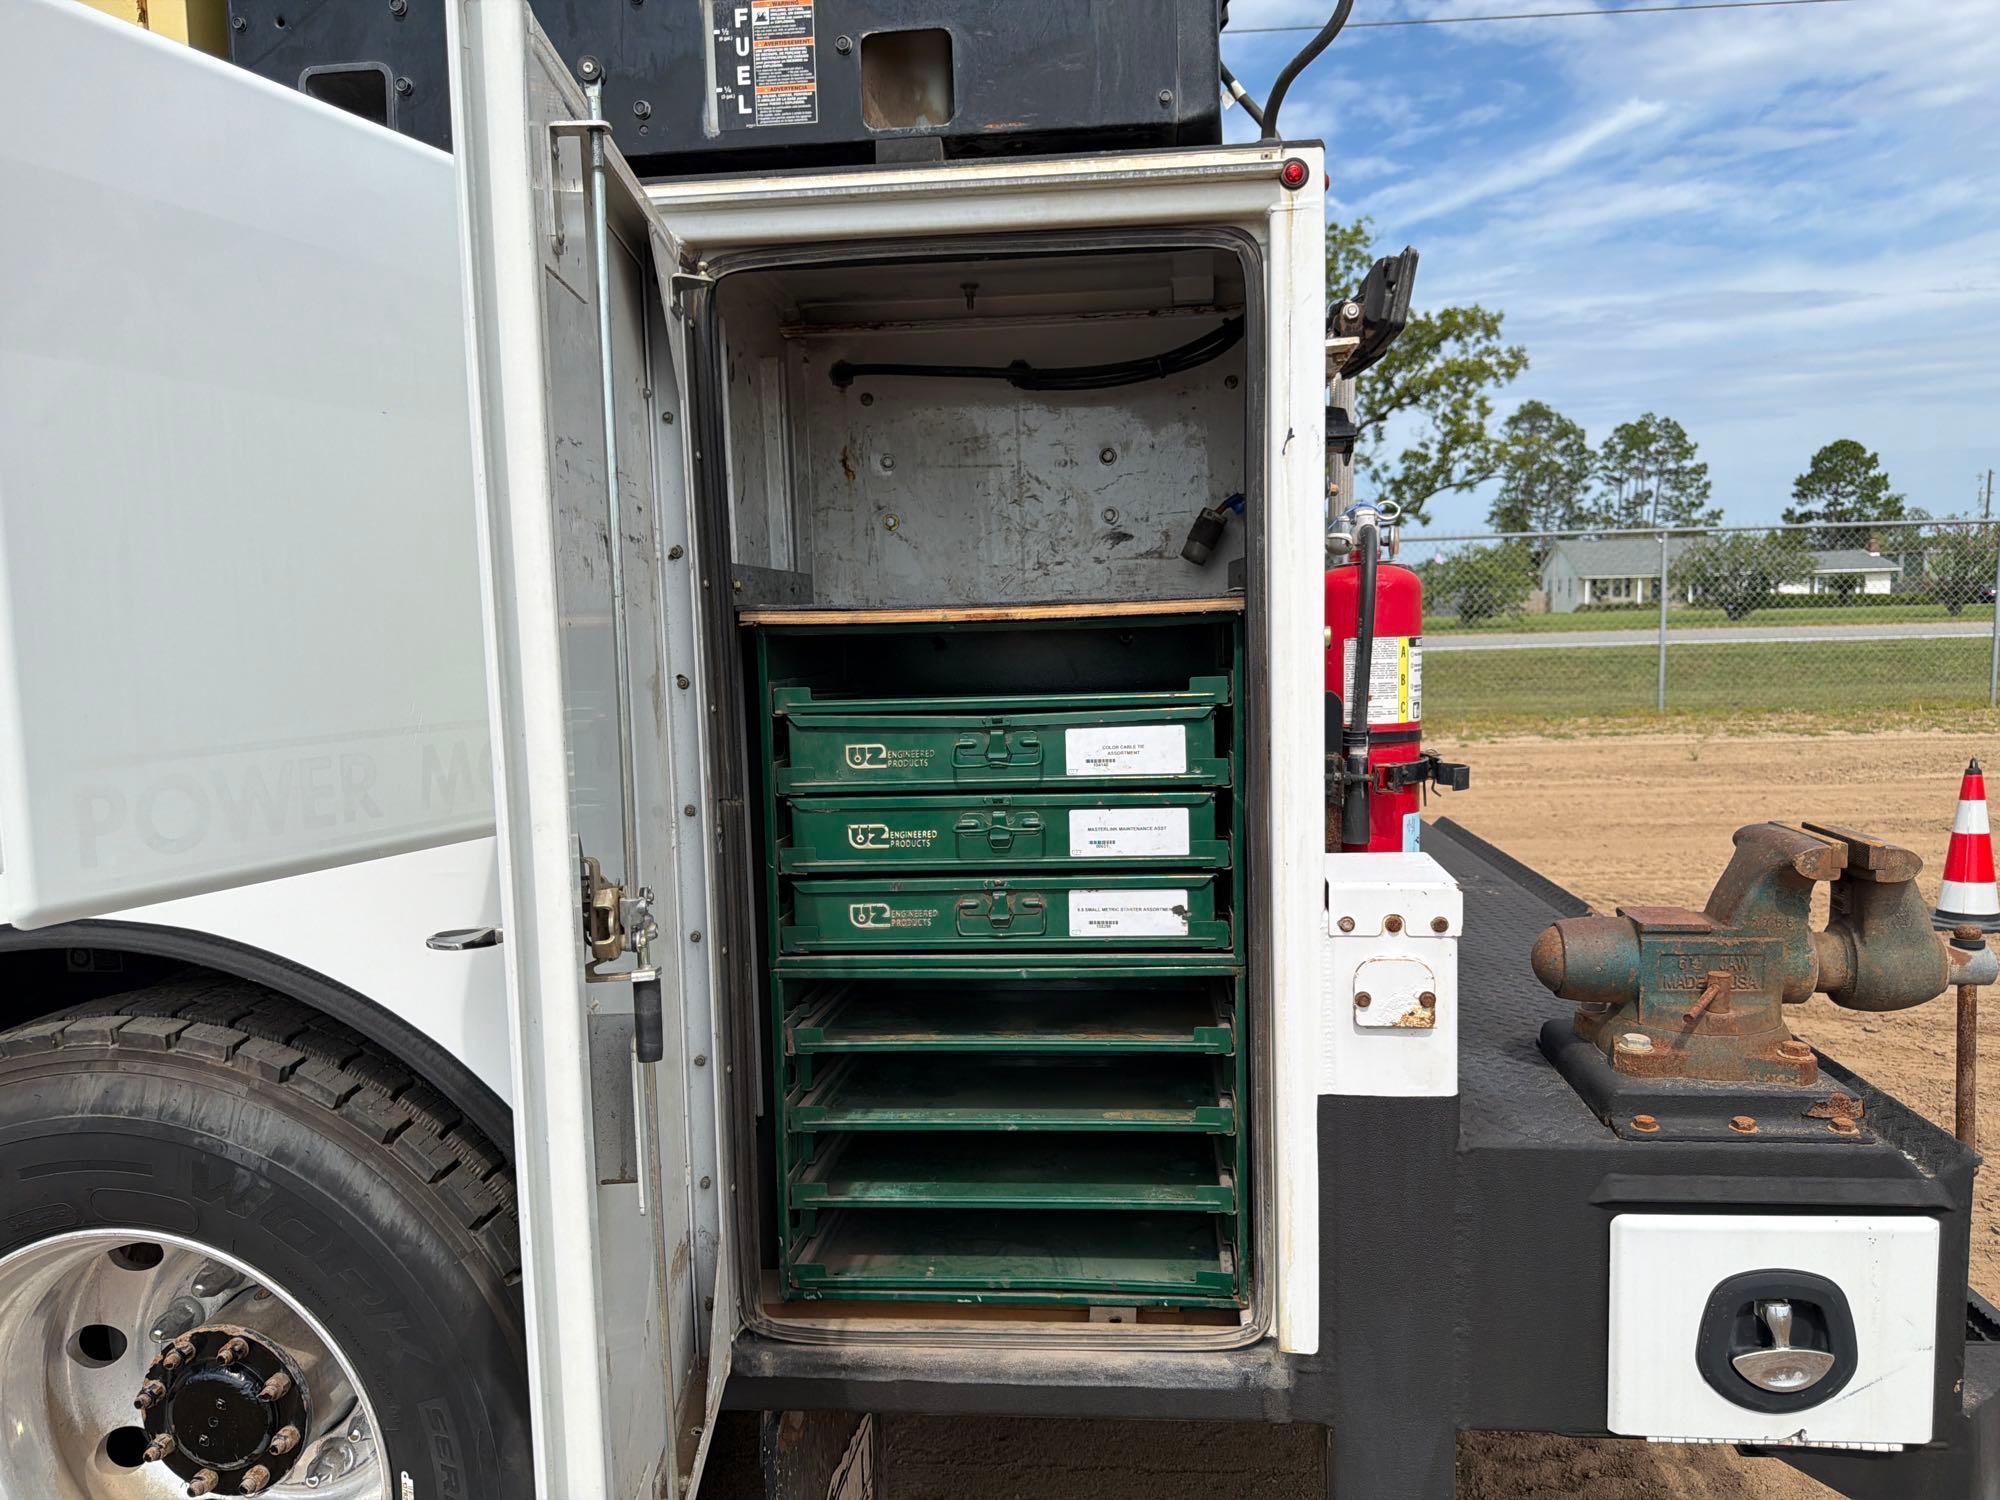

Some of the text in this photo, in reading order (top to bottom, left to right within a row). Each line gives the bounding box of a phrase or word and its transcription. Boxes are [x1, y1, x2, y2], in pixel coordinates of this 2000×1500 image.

[763, 39, 810, 47] AVERTISSEMENT
[734, 8, 752, 114] FUEL
[1400, 646, 1406, 658] A
[1400, 674, 1406, 686] B
[1400, 701, 1406, 713] C
[887, 749, 935, 759] ENGINEERED
[887, 759, 929, 767] PRODUCTS
[75, 753, 384, 869] POWER
[890, 830, 938, 839] ENGINEERED
[890, 839, 931, 848] PRODUCTS
[891, 909, 939, 918] ENGINEERED
[891, 918, 932, 927] PRODUCTS
[1719, 955, 1752, 971] JAW
[1663, 975, 1708, 990] MADE
